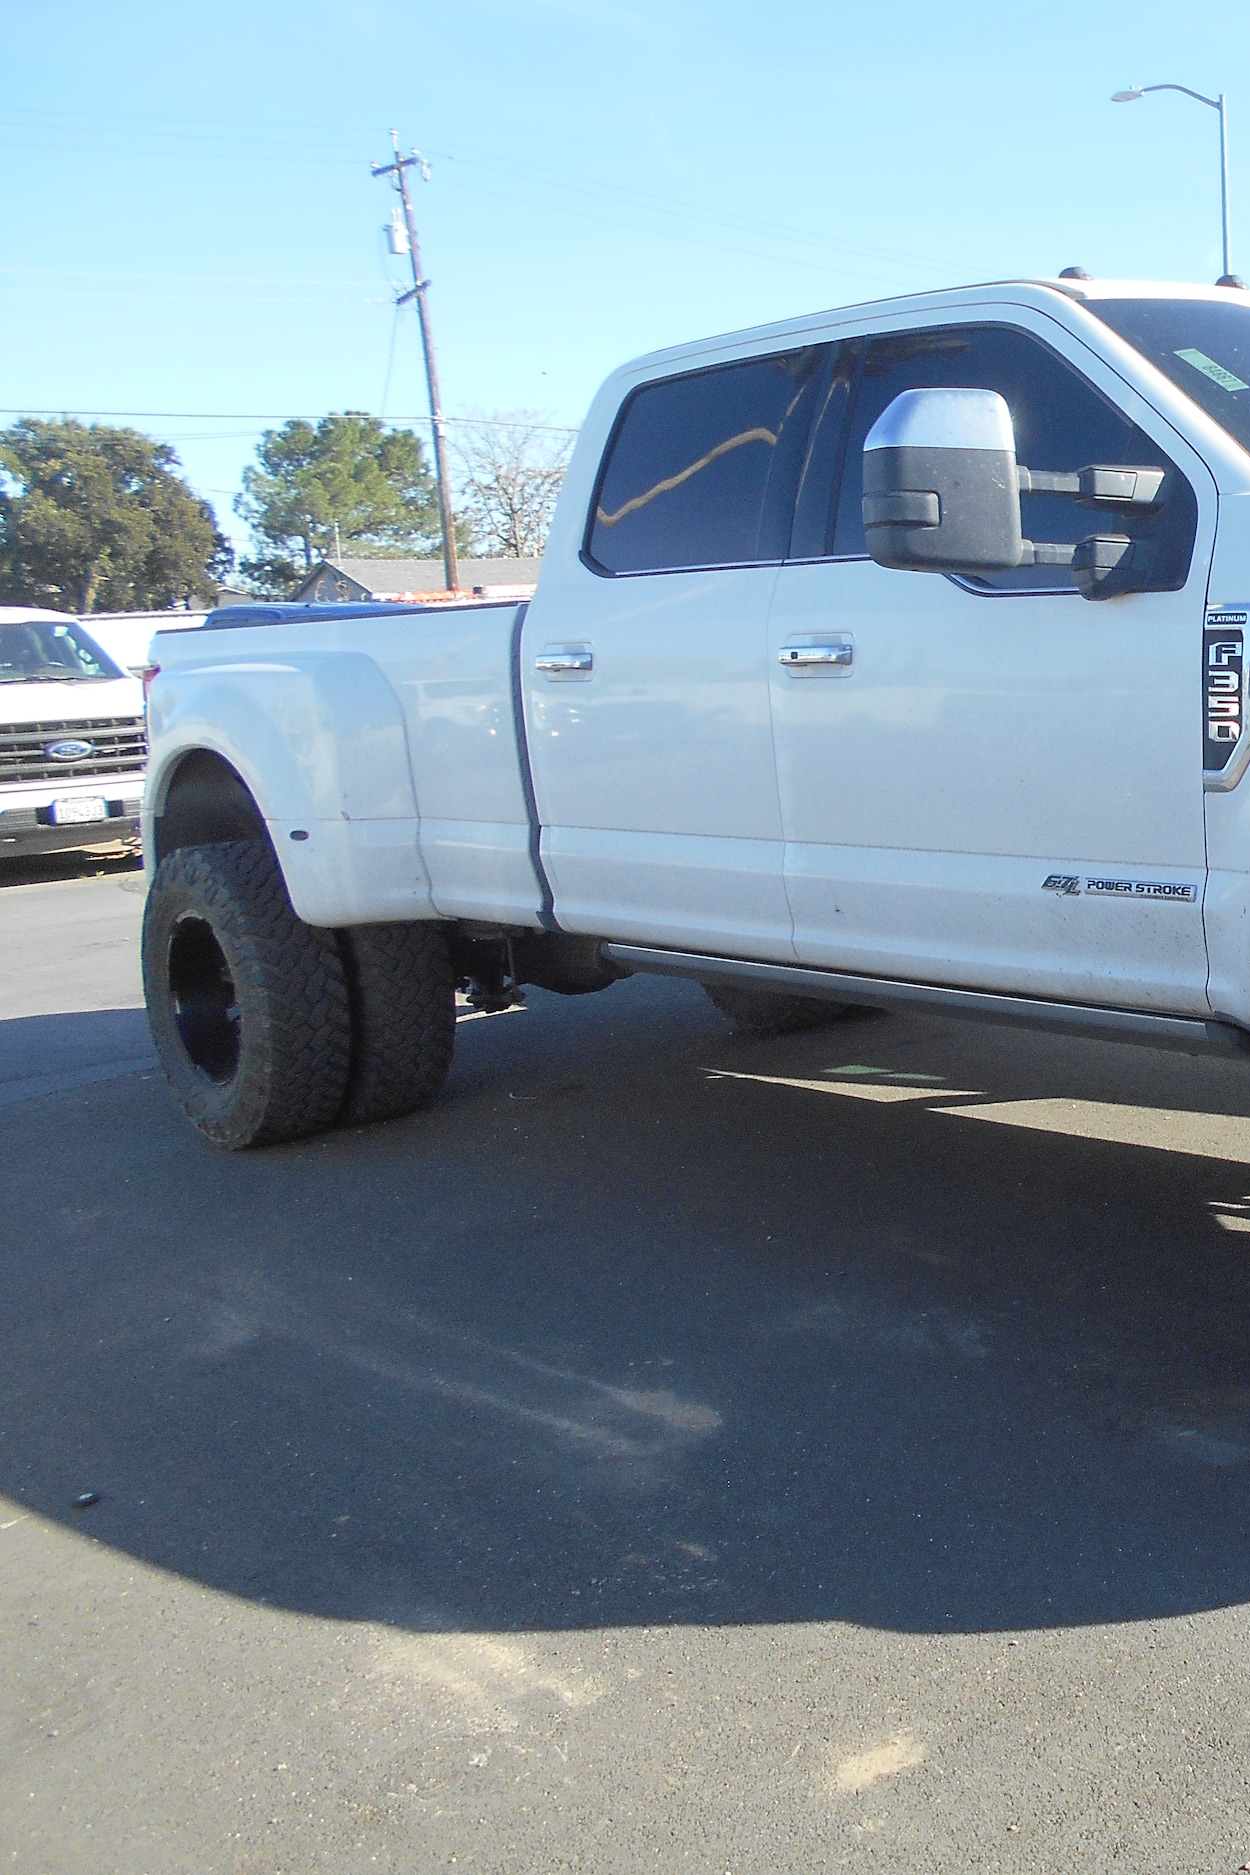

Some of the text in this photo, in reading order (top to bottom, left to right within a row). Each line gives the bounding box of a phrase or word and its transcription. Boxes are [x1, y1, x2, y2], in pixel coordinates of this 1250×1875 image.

[1208, 615, 1246, 623] PLATINUM
[1087, 880, 1132, 892] POWER
[1135, 883, 1191, 896] STROKE
